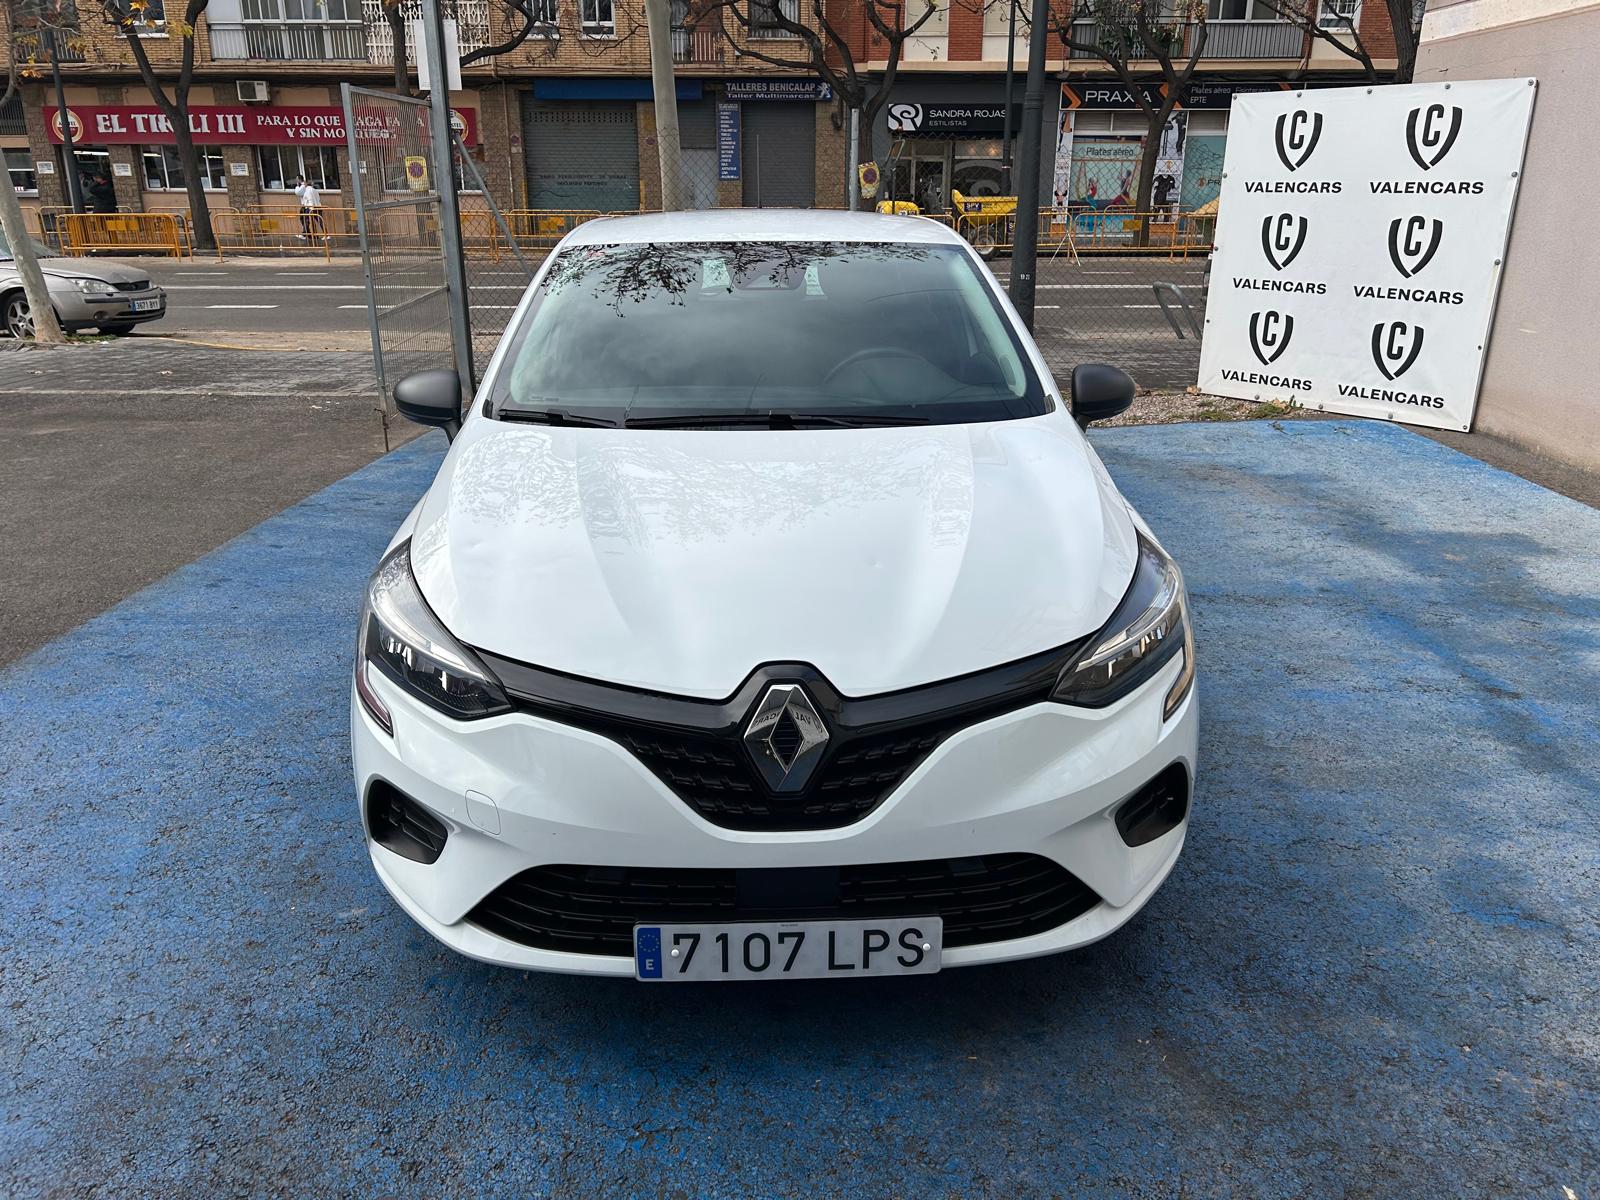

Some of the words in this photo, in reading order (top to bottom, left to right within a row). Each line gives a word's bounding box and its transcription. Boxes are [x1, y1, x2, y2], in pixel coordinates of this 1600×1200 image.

[726, 83, 767, 91] TALLERES
[769, 83, 815, 91] BENICALAP
[1085, 90, 1152, 102] PRAXA
[929, 109, 972, 118] SANDRA
[974, 109, 1006, 118] ROJAS
[95, 114, 127, 133] EL
[130, 113, 210, 133] TIRLI
[216, 114, 246, 134] III
[257, 115, 291, 126] PARA
[293, 115, 312, 126] LO
[313, 115, 341, 127] QUE
[286, 128, 296, 138] Y
[299, 128, 325, 138] SIN
[1086, 146, 1112, 156] Pilates
[1244, 181, 1342, 194] VALENCARS
[1369, 181, 1485, 194] VALENCARS
[1232, 277, 1327, 295] VALENCARS
[1353, 285, 1464, 305] VALENCARS
[1221, 369, 1313, 391] VALENCARS
[1338, 384, 1445, 409] VALENCARS
[645, 958, 654, 971] E
[672, 931, 806, 974] 7107
[828, 927, 924, 971] LPS
